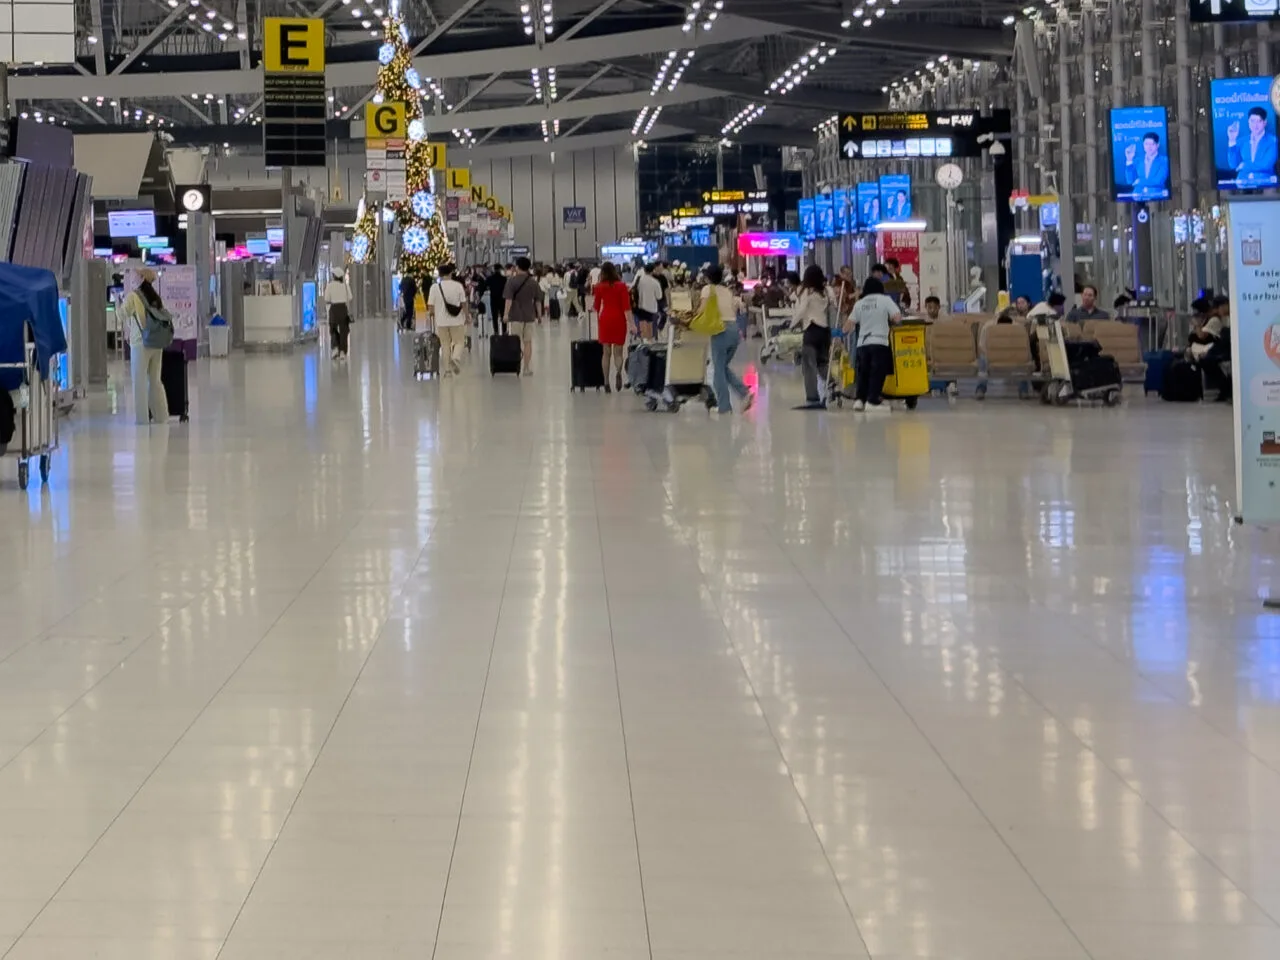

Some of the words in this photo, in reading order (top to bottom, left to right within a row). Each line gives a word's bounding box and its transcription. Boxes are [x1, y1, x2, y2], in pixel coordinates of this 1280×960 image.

[280, 24, 309, 65] E
[374, 106, 398, 133] G
[452, 170, 463, 188] L
[472, 186, 482, 201] N
[485, 198, 495, 210] Q
[567, 209, 582, 217] VAT
[1242, 292, 1280, 301] Starbu
